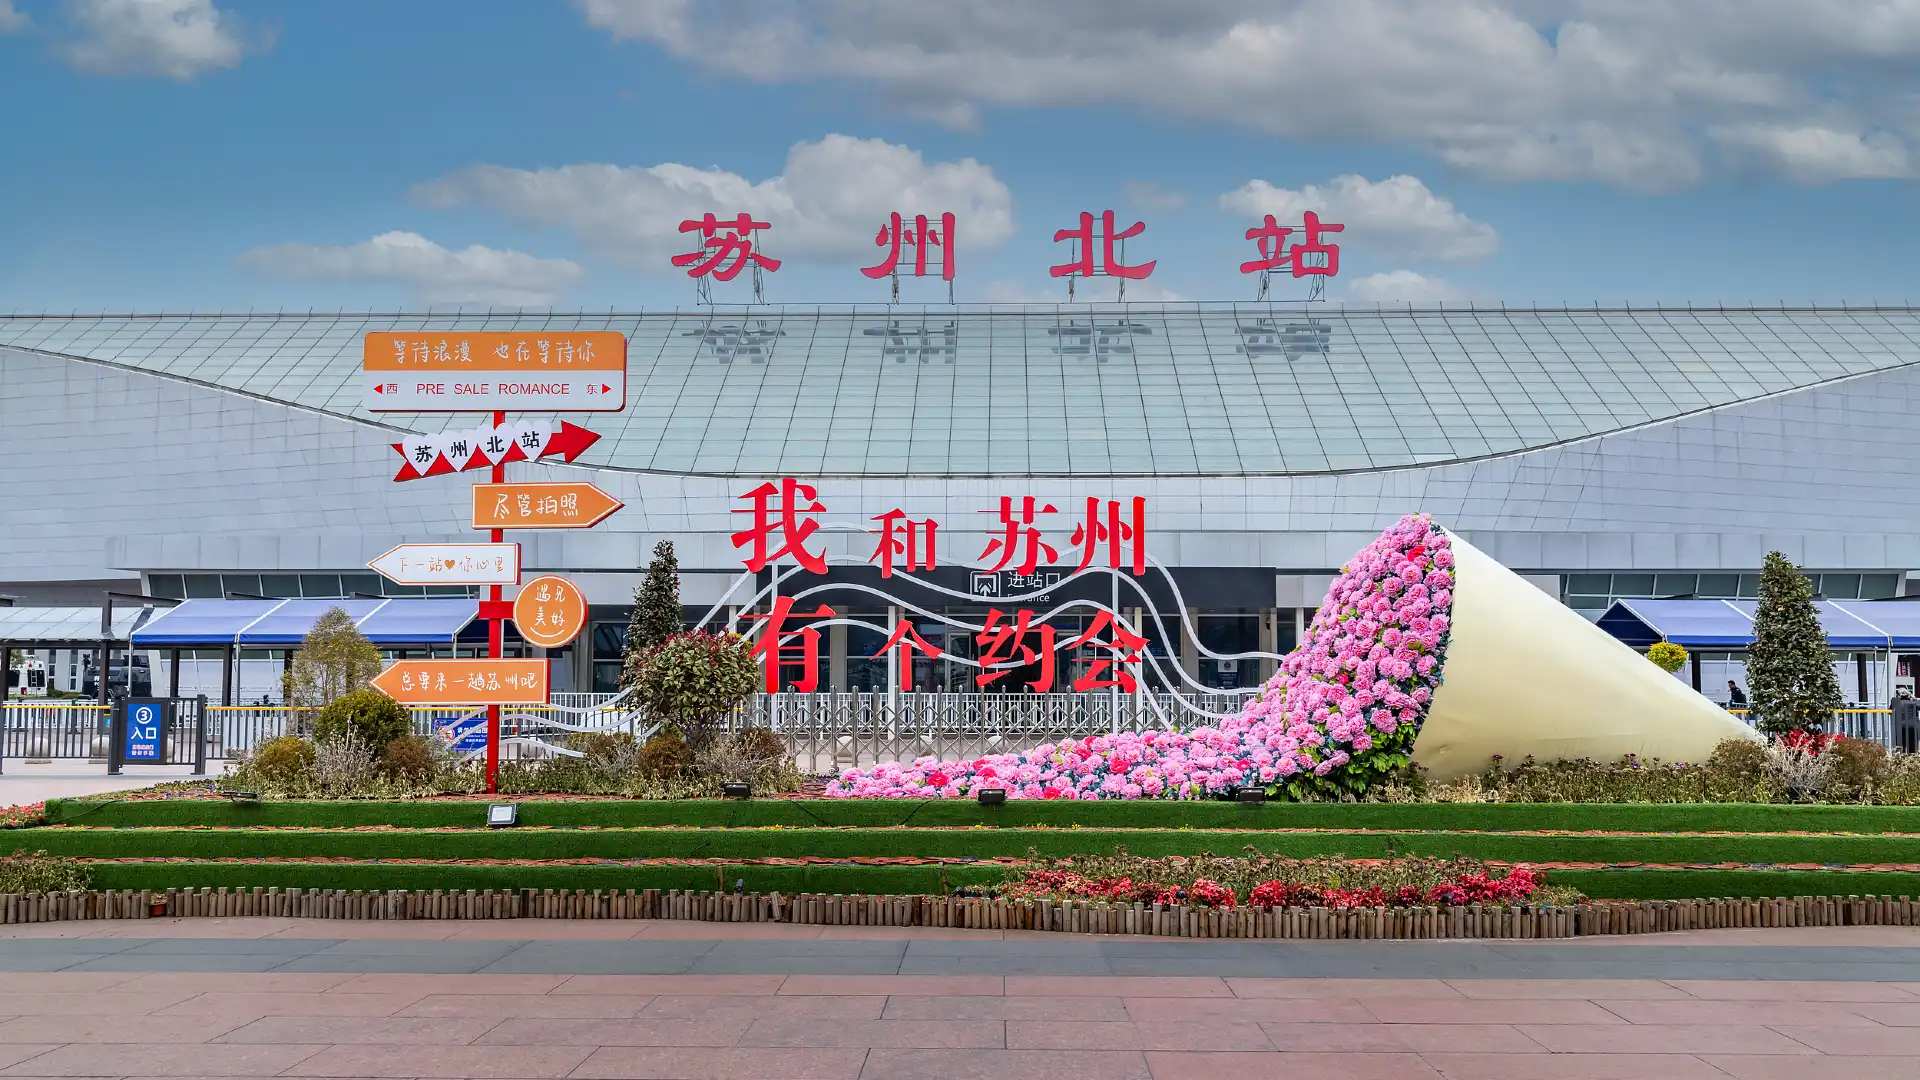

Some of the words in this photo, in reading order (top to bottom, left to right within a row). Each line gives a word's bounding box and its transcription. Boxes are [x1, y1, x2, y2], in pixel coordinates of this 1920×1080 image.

[671, 211, 1344, 281] 苏州北站
[393, 339, 472, 363] 等待浪漫
[492, 339, 595, 363] 也在等待你
[386, 383, 398, 395] 西
[416, 383, 445, 395] PRE
[453, 383, 490, 395] SALE
[498, 383, 570, 395] ROMANCE
[586, 383, 598, 395] 东
[415, 431, 541, 463] 苏州北站
[493, 492, 579, 519] 尽管拍照
[731, 477, 1145, 578] 我和苏州
[1007, 571, 1061, 588] 进站口
[535, 584, 566, 603] 遇见
[1007, 594, 1050, 602] ance
[535, 607, 566, 628] 美好
[739, 595, 1149, 695] 有个约会
[401, 671, 538, 692] 总要来一趟苏州吧
[131, 726, 157, 740] 入口
